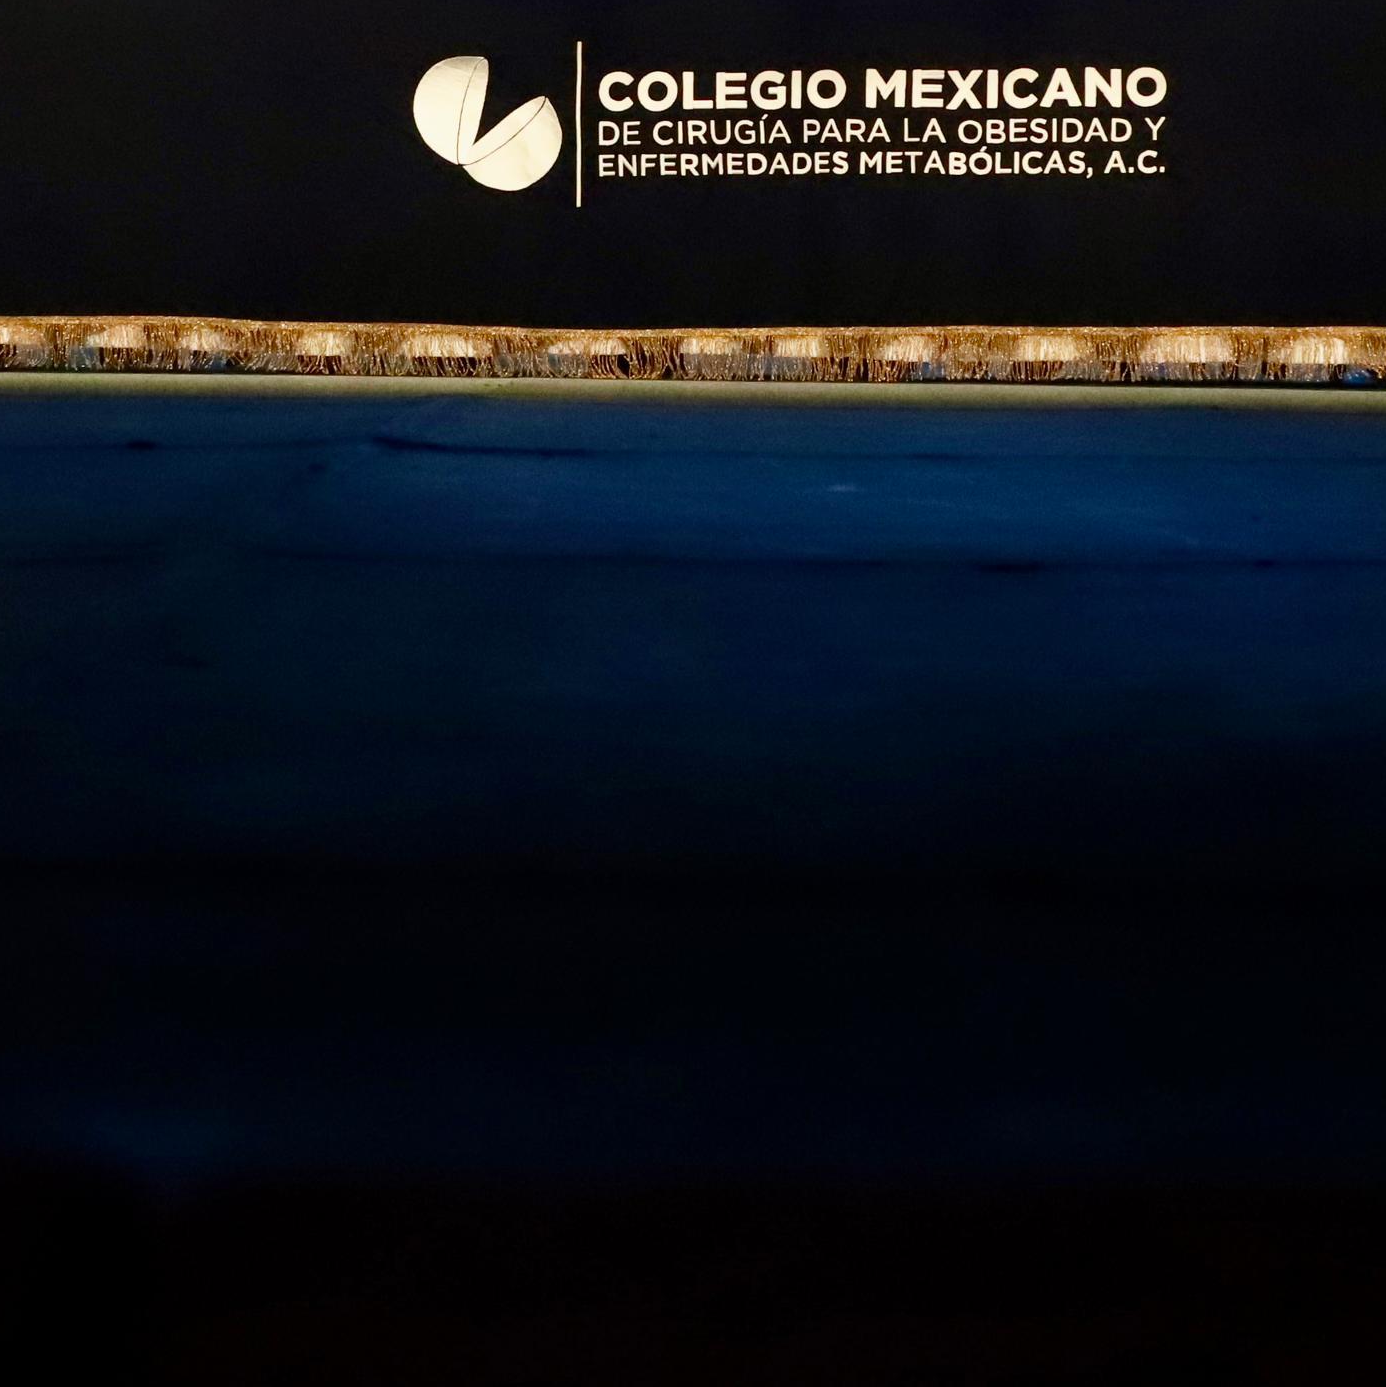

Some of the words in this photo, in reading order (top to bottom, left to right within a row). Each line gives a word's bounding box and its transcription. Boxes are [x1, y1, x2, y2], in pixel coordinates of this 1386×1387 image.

[598, 69, 847, 112] COLEGIO
[865, 66, 1167, 110] MEXICANO
[598, 120, 641, 146] DE
[652, 113, 792, 146] CIRUGÍA
[803, 117, 891, 143] PARA
[903, 117, 946, 144] LA
[957, 117, 1133, 145] OBESIDAD
[1144, 116, 1166, 141] Y
[598, 150, 849, 177] ENFERMEDADES
[859, 145, 1093, 179] METABÓLICAS,
[1104, 150, 1166, 174] A.C.
